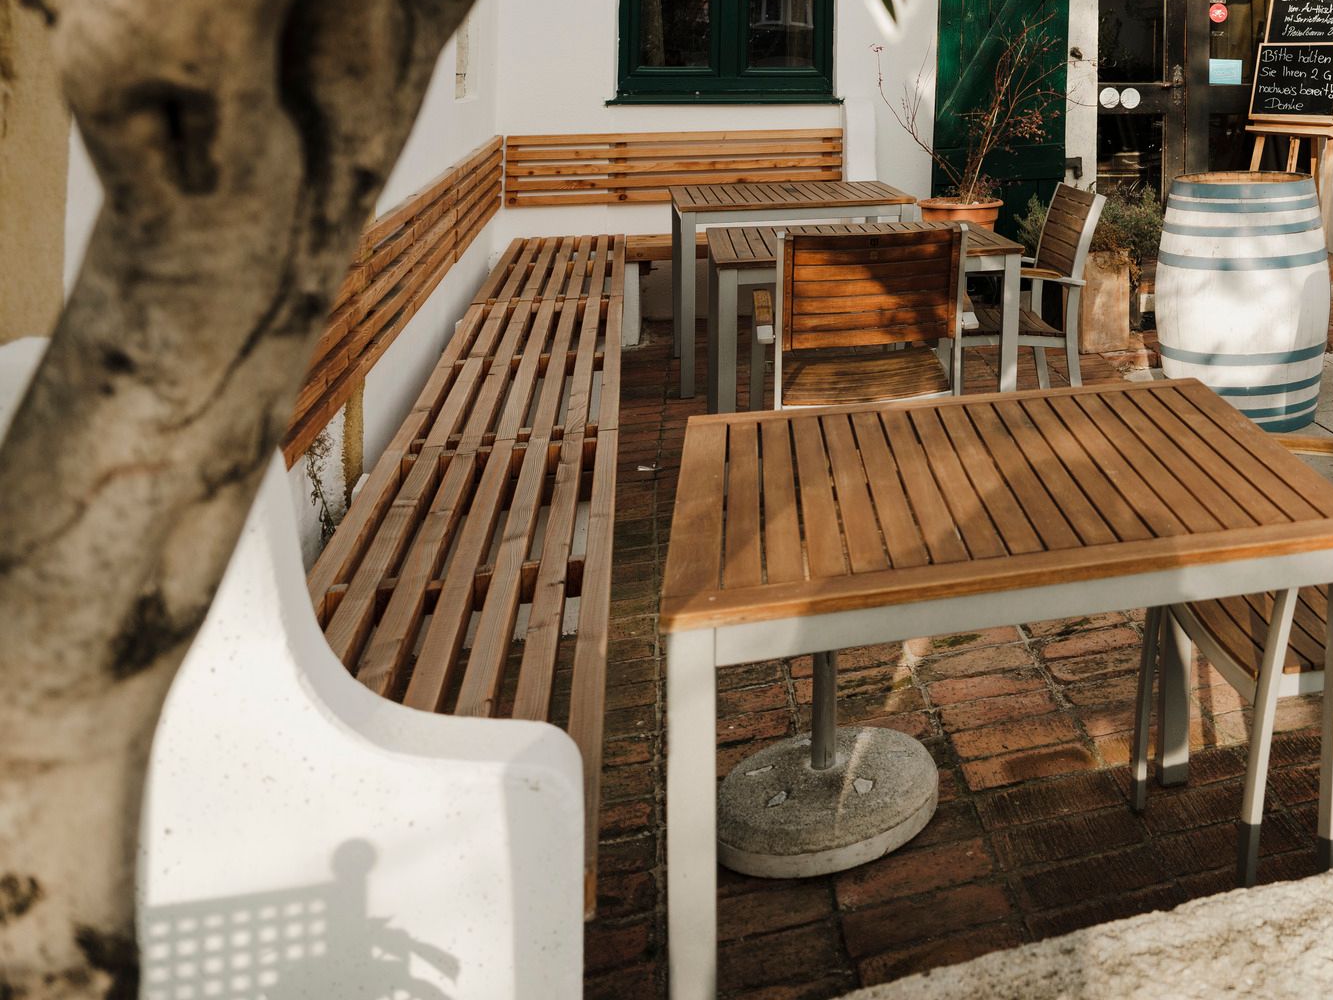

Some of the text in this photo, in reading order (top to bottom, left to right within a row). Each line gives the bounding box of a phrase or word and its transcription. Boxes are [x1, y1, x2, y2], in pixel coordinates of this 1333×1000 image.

[1261, 47, 1332, 64] Bitte halten
[1259, 65, 1332, 81] Sie Ihren 2 G
[1258, 82, 1298, 96] nachweis
[1264, 97, 1304, 111] Danke
